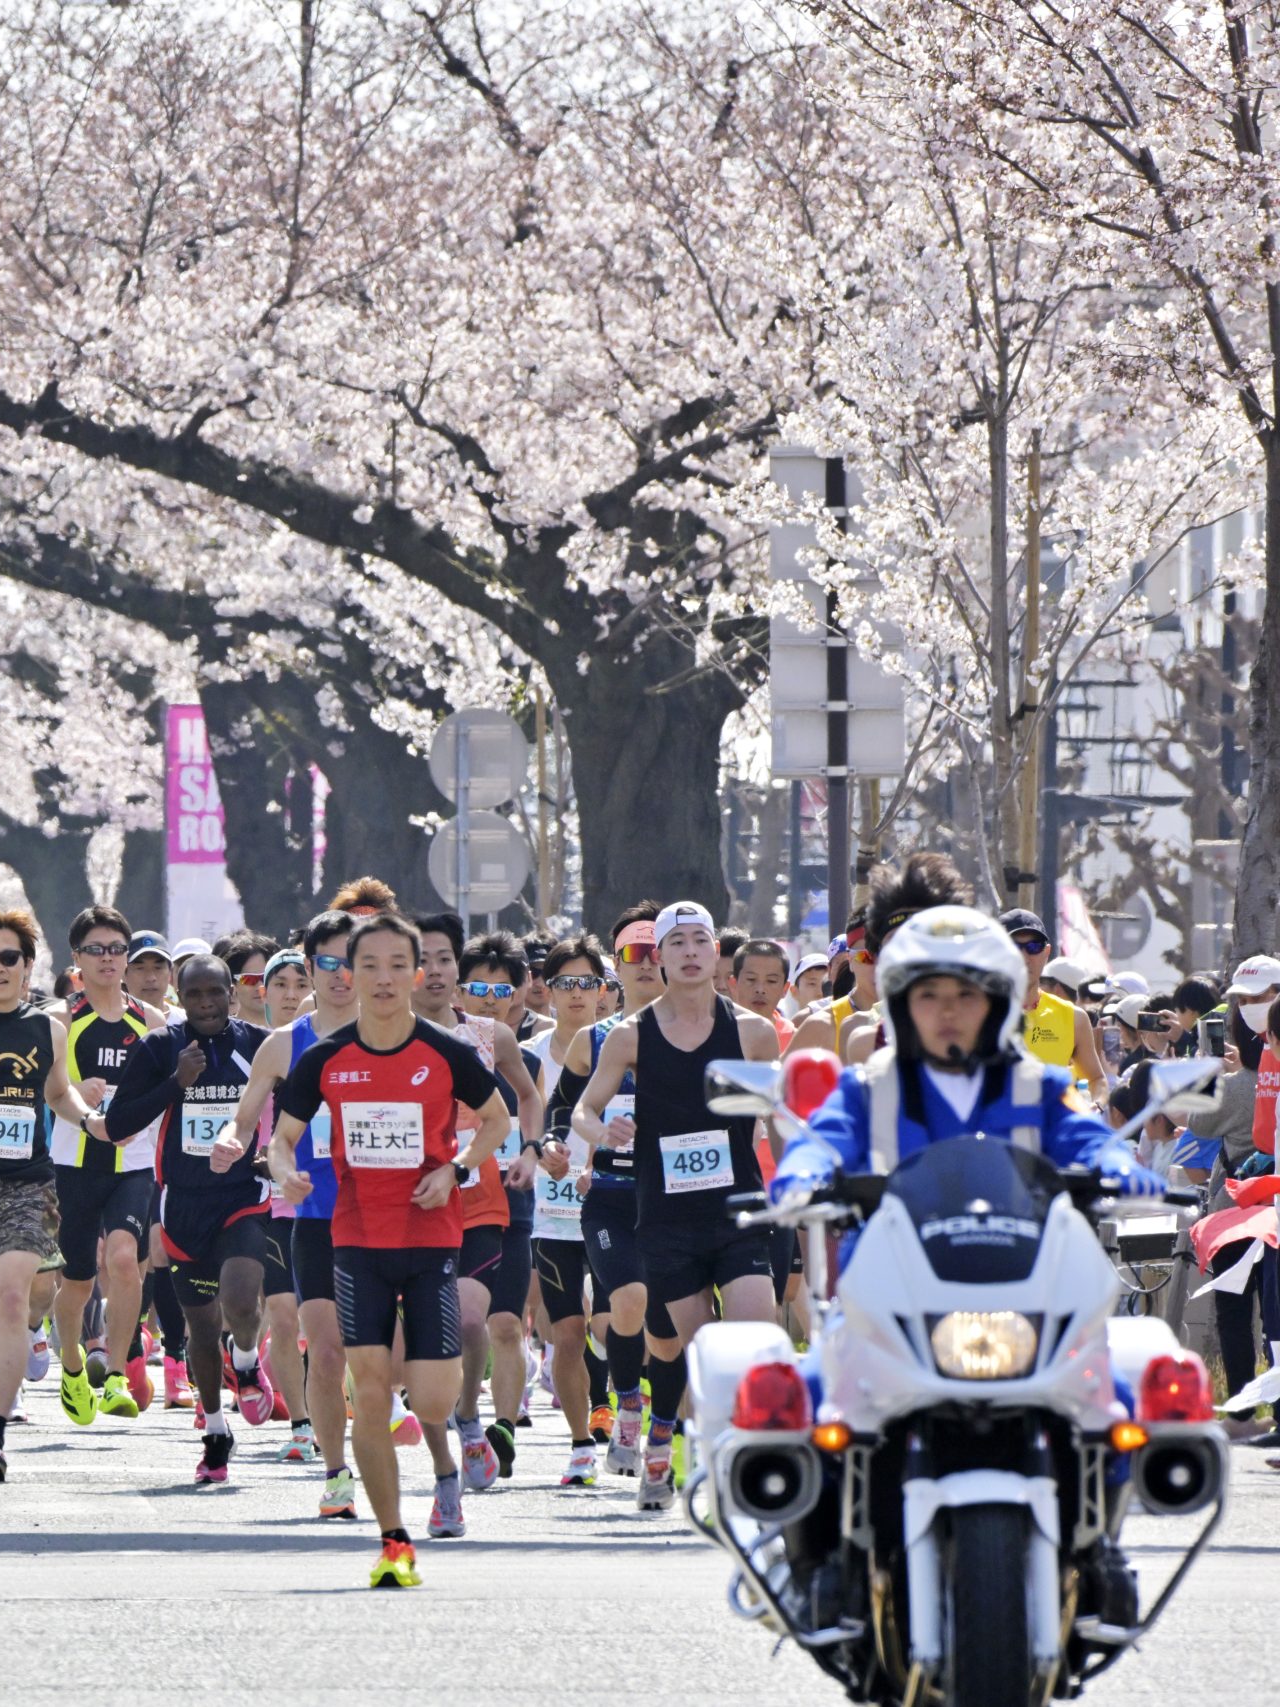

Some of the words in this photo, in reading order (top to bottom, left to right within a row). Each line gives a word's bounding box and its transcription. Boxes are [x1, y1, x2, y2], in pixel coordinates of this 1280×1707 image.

[97, 1047, 128, 1068] IRF
[328, 1071, 372, 1084] 三菱重工
[348, 1131, 420, 1150] 井上大仁
[679, 1135, 709, 1144] HITACHI
[672, 1148, 721, 1174] 489
[920, 1214, 1040, 1239] POLICE
